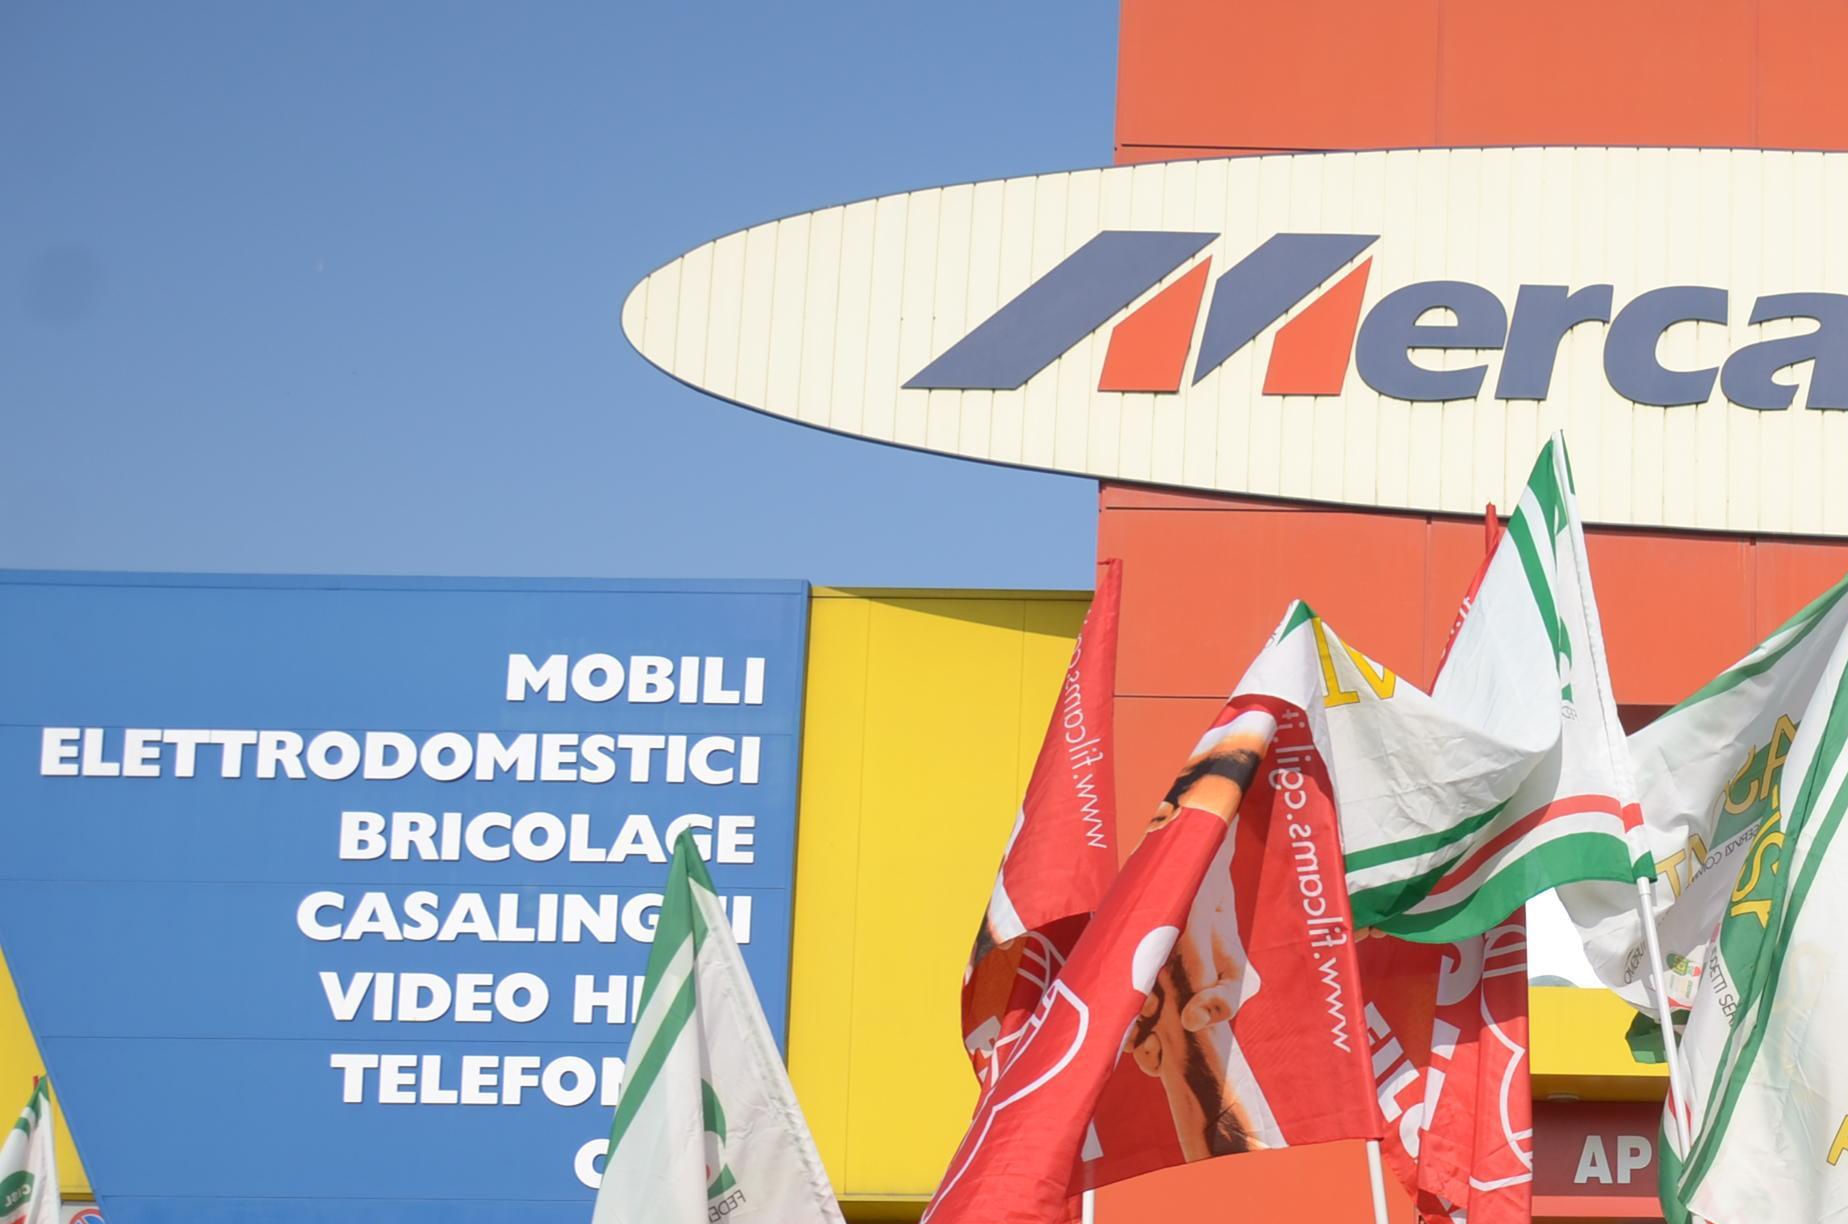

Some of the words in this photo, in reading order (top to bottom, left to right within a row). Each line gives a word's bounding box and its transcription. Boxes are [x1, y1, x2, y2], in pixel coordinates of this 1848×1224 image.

[506, 654, 765, 705] MOBILI
[39, 727, 760, 785] ELETTRODOMESTICI
[339, 811, 756, 864] BRICOLAGE
[296, 891, 753, 944] CASALINGI
[320, 971, 549, 1022] VIDEO
